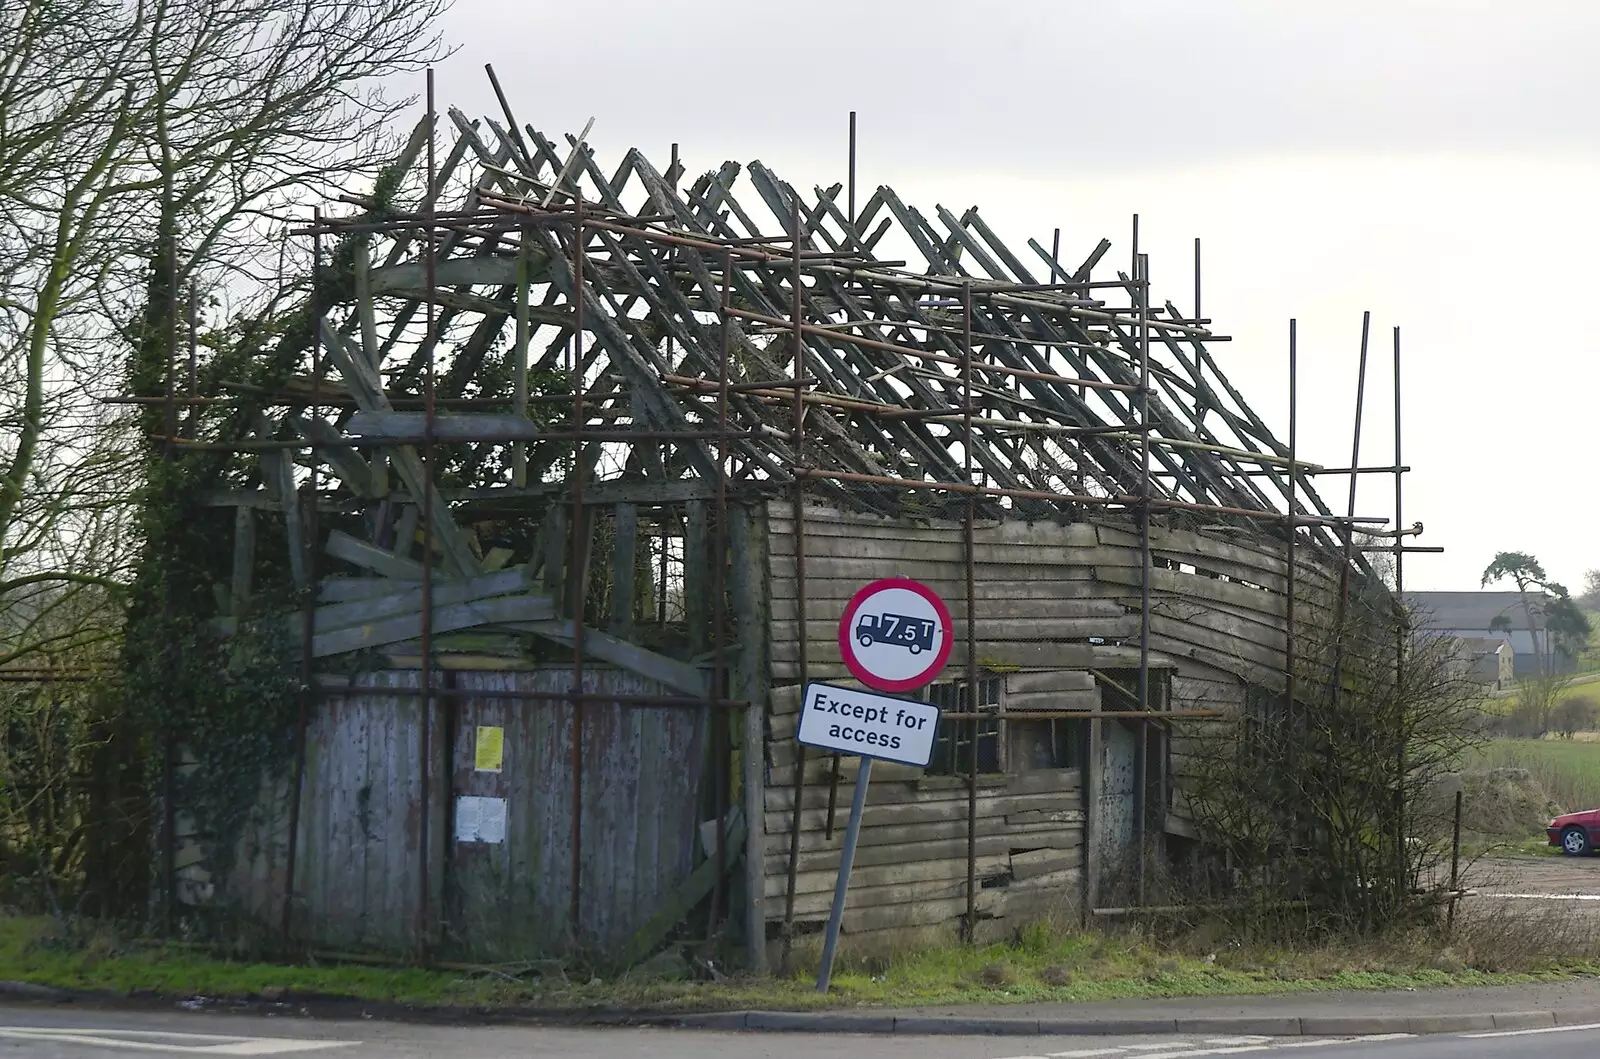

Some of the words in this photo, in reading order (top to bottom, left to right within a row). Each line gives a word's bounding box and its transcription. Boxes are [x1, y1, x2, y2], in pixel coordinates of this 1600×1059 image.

[813, 693, 888, 723] Except
[896, 710, 927, 730] for
[829, 724, 901, 749] access
